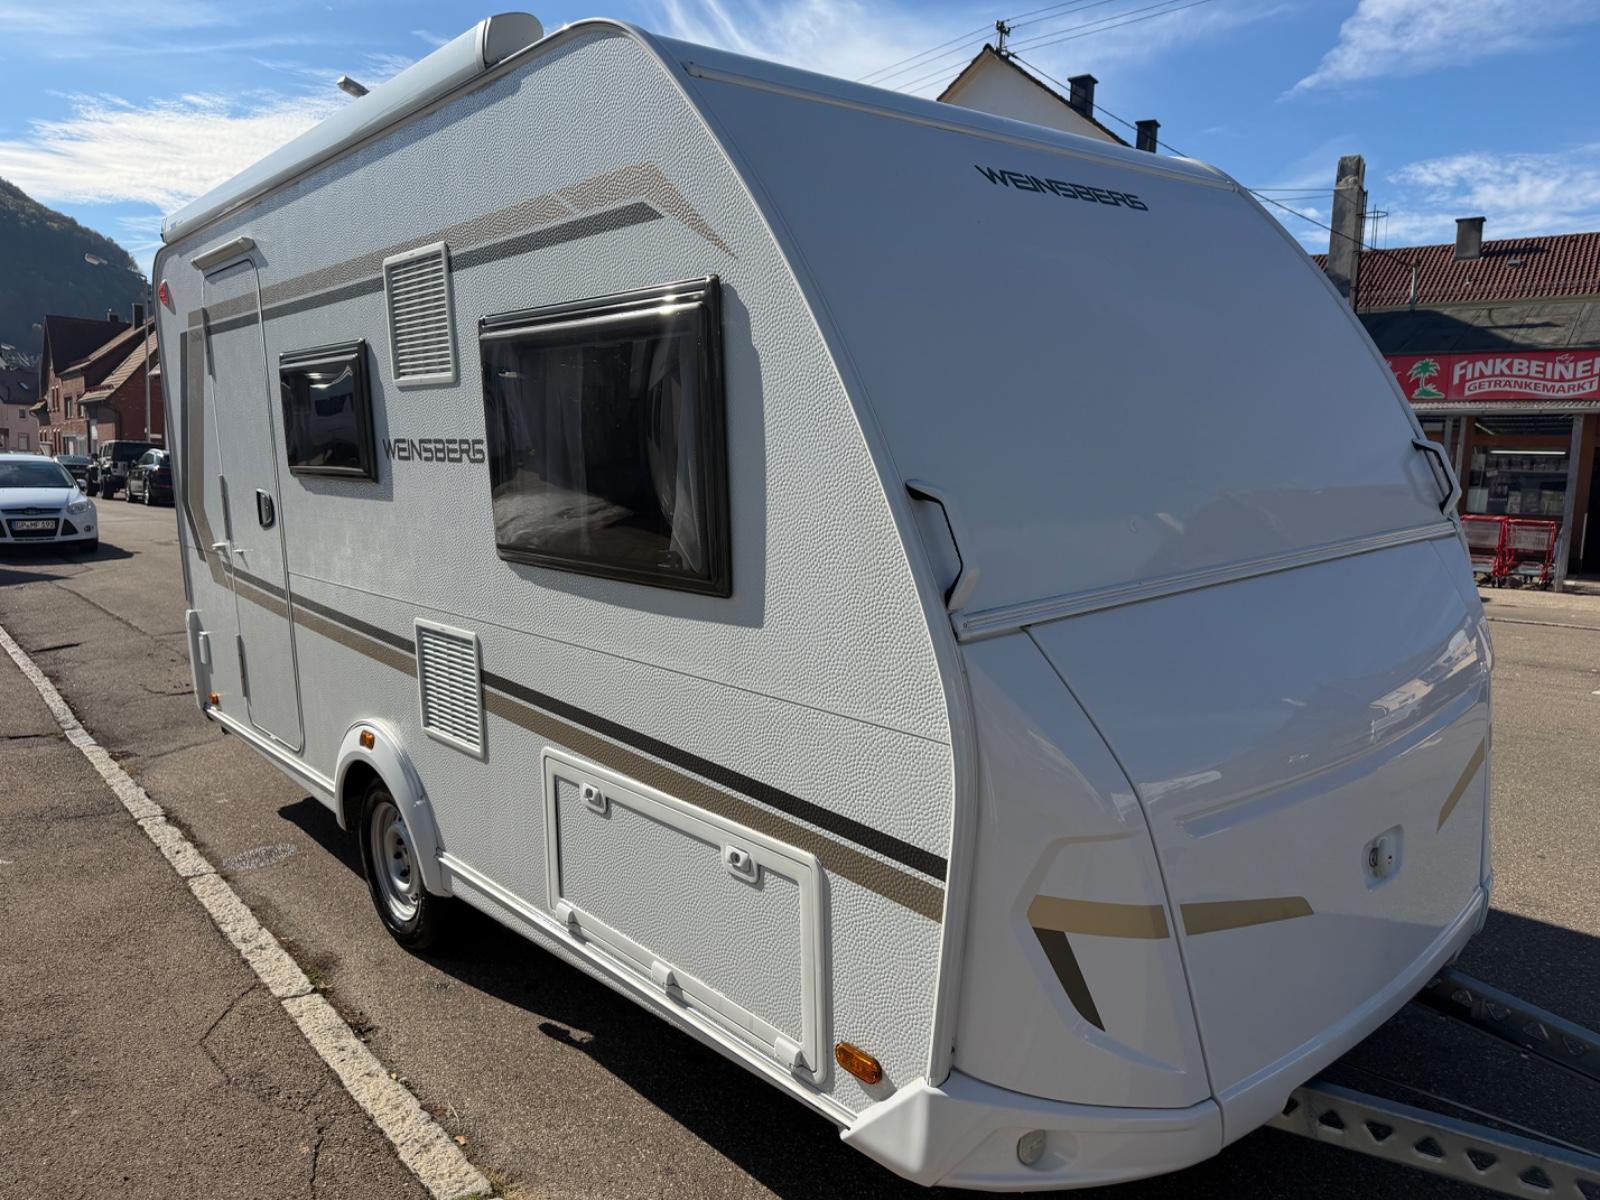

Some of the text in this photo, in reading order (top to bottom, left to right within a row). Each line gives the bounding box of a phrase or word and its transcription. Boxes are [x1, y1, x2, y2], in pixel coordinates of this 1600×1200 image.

[974, 164, 1149, 211] WEINSBERG
[1467, 379, 1594, 394] GETRÄNKEMARKT
[383, 438, 485, 463] WEINSBERG
